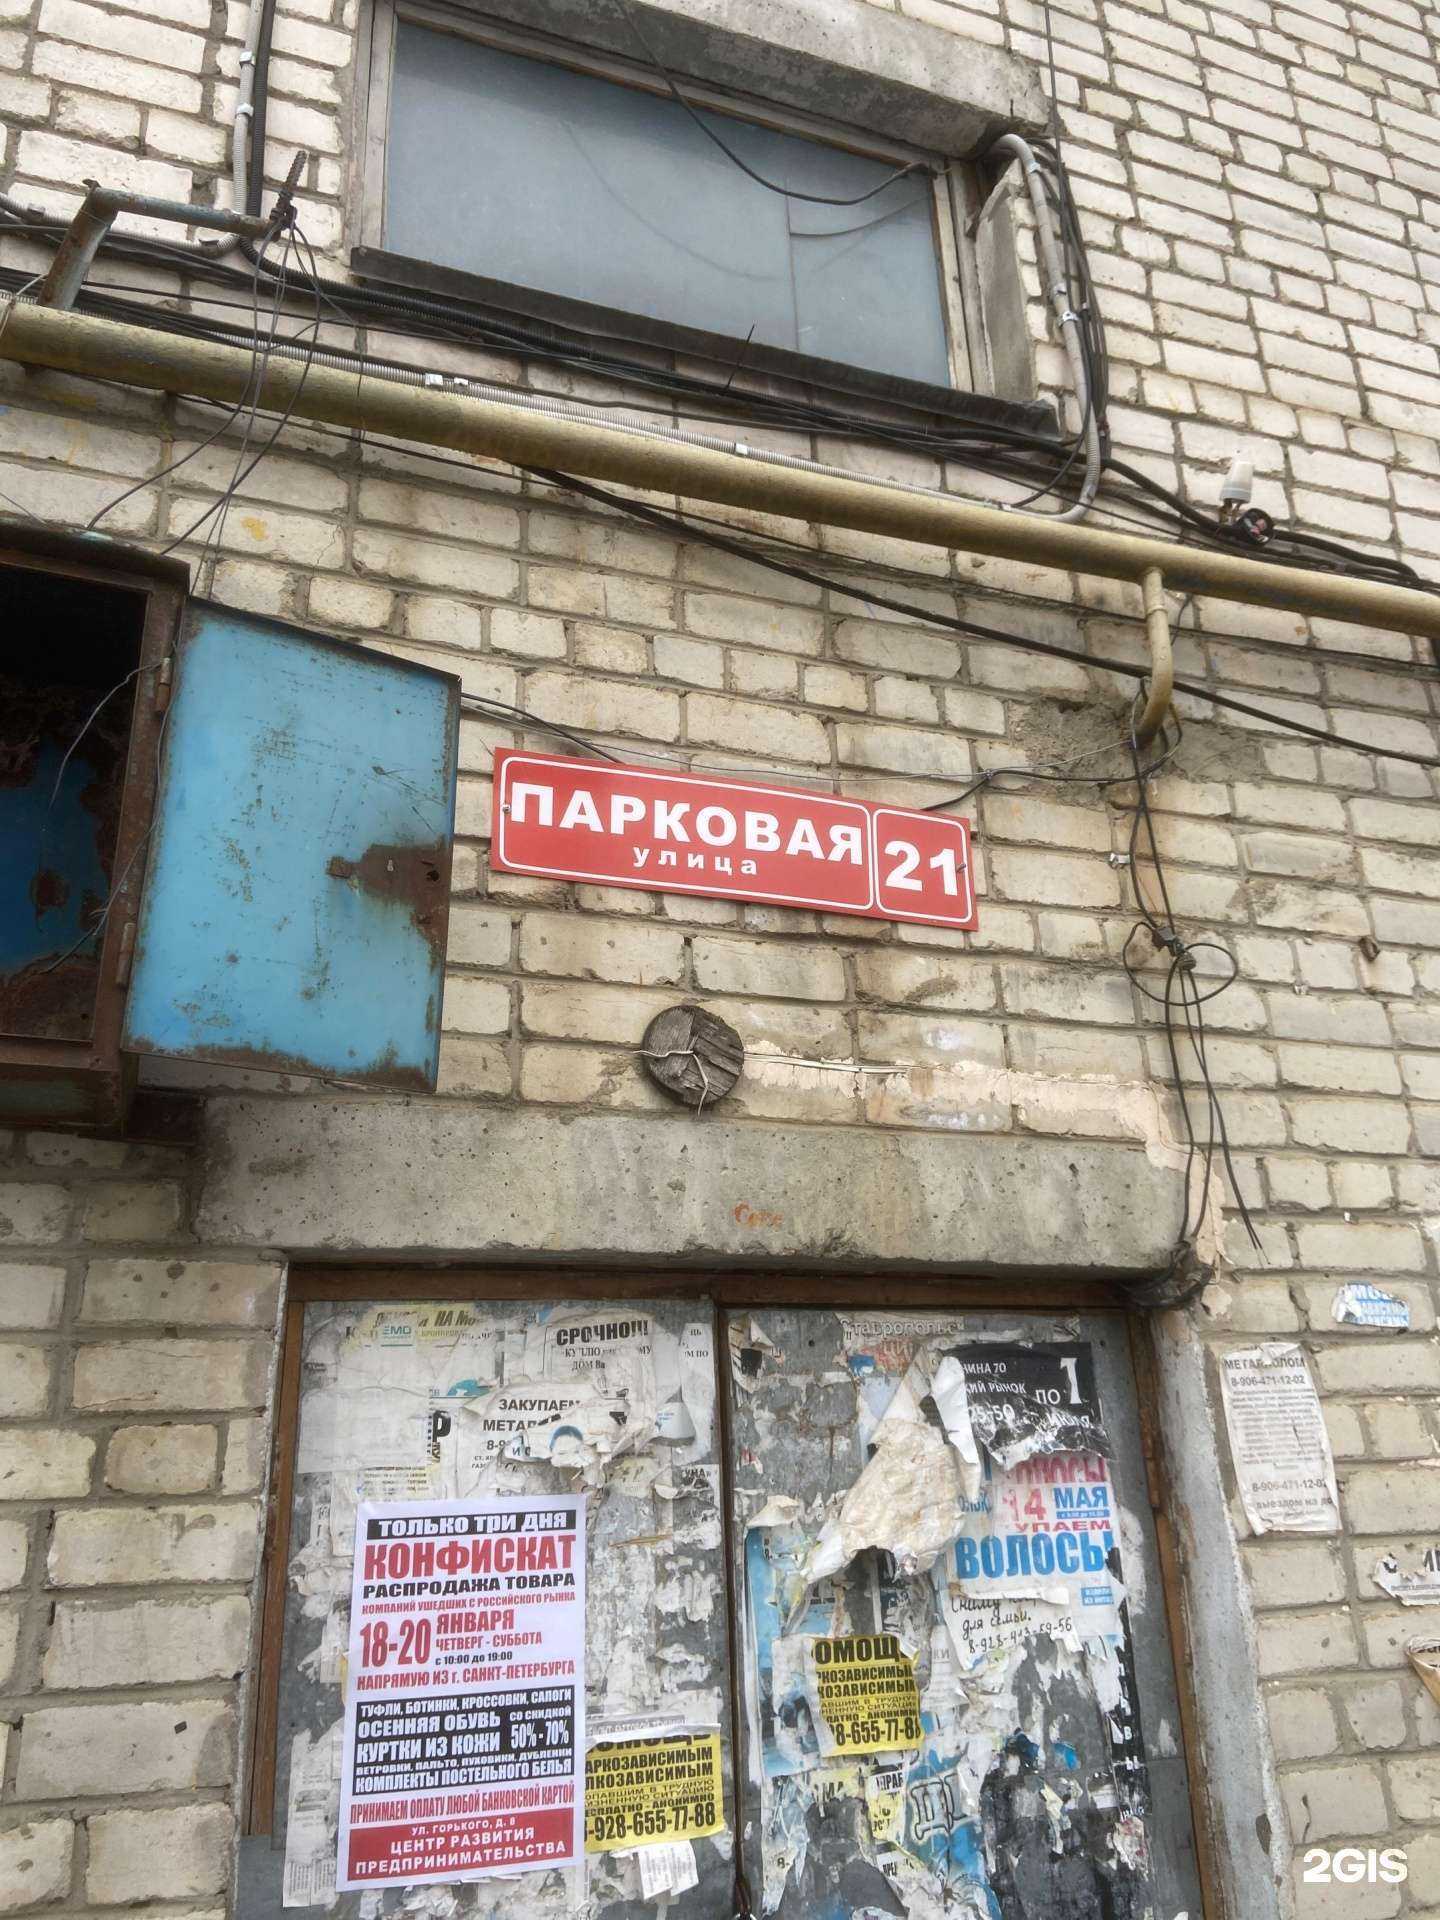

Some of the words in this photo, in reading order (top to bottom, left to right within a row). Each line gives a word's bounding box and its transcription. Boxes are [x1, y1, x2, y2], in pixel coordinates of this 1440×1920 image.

[511, 782, 863, 865] ПАРКОВАЯ
[633, 844, 758, 876] улица
[884, 840, 959, 897] 21
[994, 1362, 1007, 1374] 70
[1035, 1389, 1061, 1405] ПО
[1060, 1357, 1082, 1405] 1
[989, 1382, 1027, 1394] РЫНОК
[1053, 1486, 1109, 1508] МАЯ
[1014, 1520, 1111, 1533] УПАЕМ
[364, 1535, 576, 1580] КОНФИСКАТ
[955, 1531, 1114, 1579] ВОЛОСЫ
[363, 1577, 500, 1599] РАСПРОДАЖА
[505, 1573, 576, 1590] ТОВАРА
[362, 1602, 416, 1616] КОМПАНИЙ
[418, 1599, 468, 1612] УШЕДШИХ
[477, 1593, 542, 1608] РОССИЙСКОГО
[543, 1592, 576, 1603] РЫНКА
[360, 1618, 432, 1668] 18-20
[436, 1609, 514, 1635] ЯНВАРЯ
[435, 1636, 484, 1652] ЧЕТВЕРГ
[493, 1631, 543, 1648] СУББОТА
[812, 1637, 909, 1664] ОМОЩ
[444, 1655, 470, 1665] 10:00
[472, 1653, 485, 1664] до
[488, 1651, 513, 1662] 19:00
[357, 1672, 430, 1691] НАПРЯМУЮ
[432, 1670, 449, 1686] ИЗ
[462, 1660, 575, 1683] САНКТ-ПЕТЕРБУРГА
[361, 1704, 404, 1718] ТУФЛИ,
[530, 1689, 572, 1704] САПОГИ
[358, 1715, 440, 1739] ОСЕННЯЯ
[444, 1712, 501, 1731] ОБУВЬ
[510, 1722, 537, 1749] 50%
[545, 1720, 569, 1746] 70%
[356, 1739, 423, 1764] КУРТКИ
[426, 1737, 448, 1758] ИЗ
[451, 1732, 501, 1755] КОЖИ
[585, 1746, 712, 1774] АРКОЗАВИСИМЫМ
[355, 1772, 440, 1793] КОМПЛЕКТЫ
[441, 1763, 530, 1786] ПОСТЕЛЬНОГО
[532, 1758, 572, 1777] БЕЛЬЯ
[586, 1762, 713, 1790] ЛКОЗАВИСИМЫМ
[586, 1788, 644, 1800] ОПАВШИМ
[664, 1779, 714, 1792] ТРУДНУЮ
[350, 1802, 408, 1824] ПРИНИМАЕМ
[410, 1797, 446, 1819] ОПЛАТУ
[446, 1790, 480, 1814] ЛЮБОЙ
[482, 1783, 541, 1812] БАНКОВСКОЙ
[541, 1780, 575, 1806] КАРТОЙ
[586, 1794, 650, 1808] ИЗНЕННУЮ
[586, 1803, 643, 1818] ЕСПЛАТНО
[652, 1793, 714, 1809] АНОНИМНО
[391, 1838, 445, 1855] ЦЕНТР
[451, 1827, 536, 1848] РАЗВИТИЯ
[411, 1826, 429, 1836] УЛ.
[356, 1842, 566, 1874] ПРЕДПРИНИМАТЕЛЬСТВА
